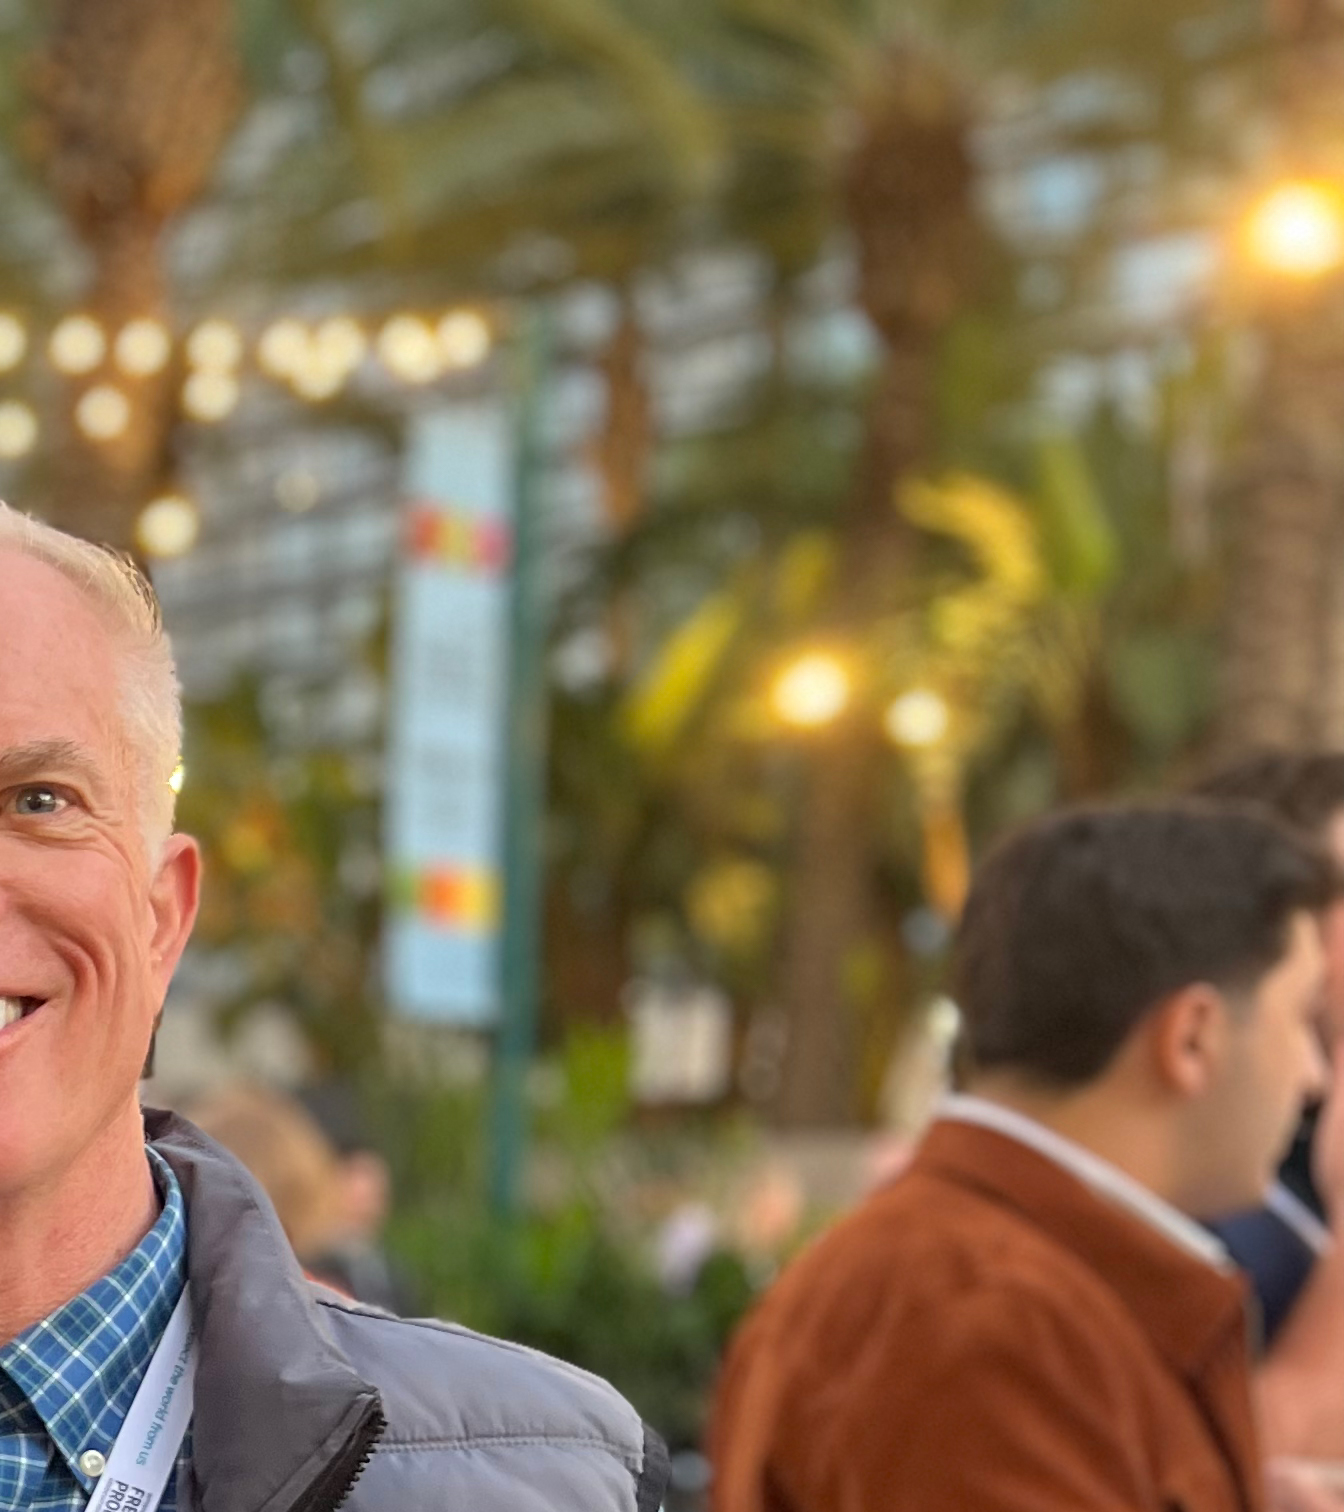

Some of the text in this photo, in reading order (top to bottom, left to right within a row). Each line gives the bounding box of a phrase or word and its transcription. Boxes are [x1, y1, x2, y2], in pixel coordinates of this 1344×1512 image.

[170, 1364, 185, 1386] the
[154, 1386, 174, 1422] world
[142, 1421, 162, 1451] from
[136, 1450, 149, 1466] us
